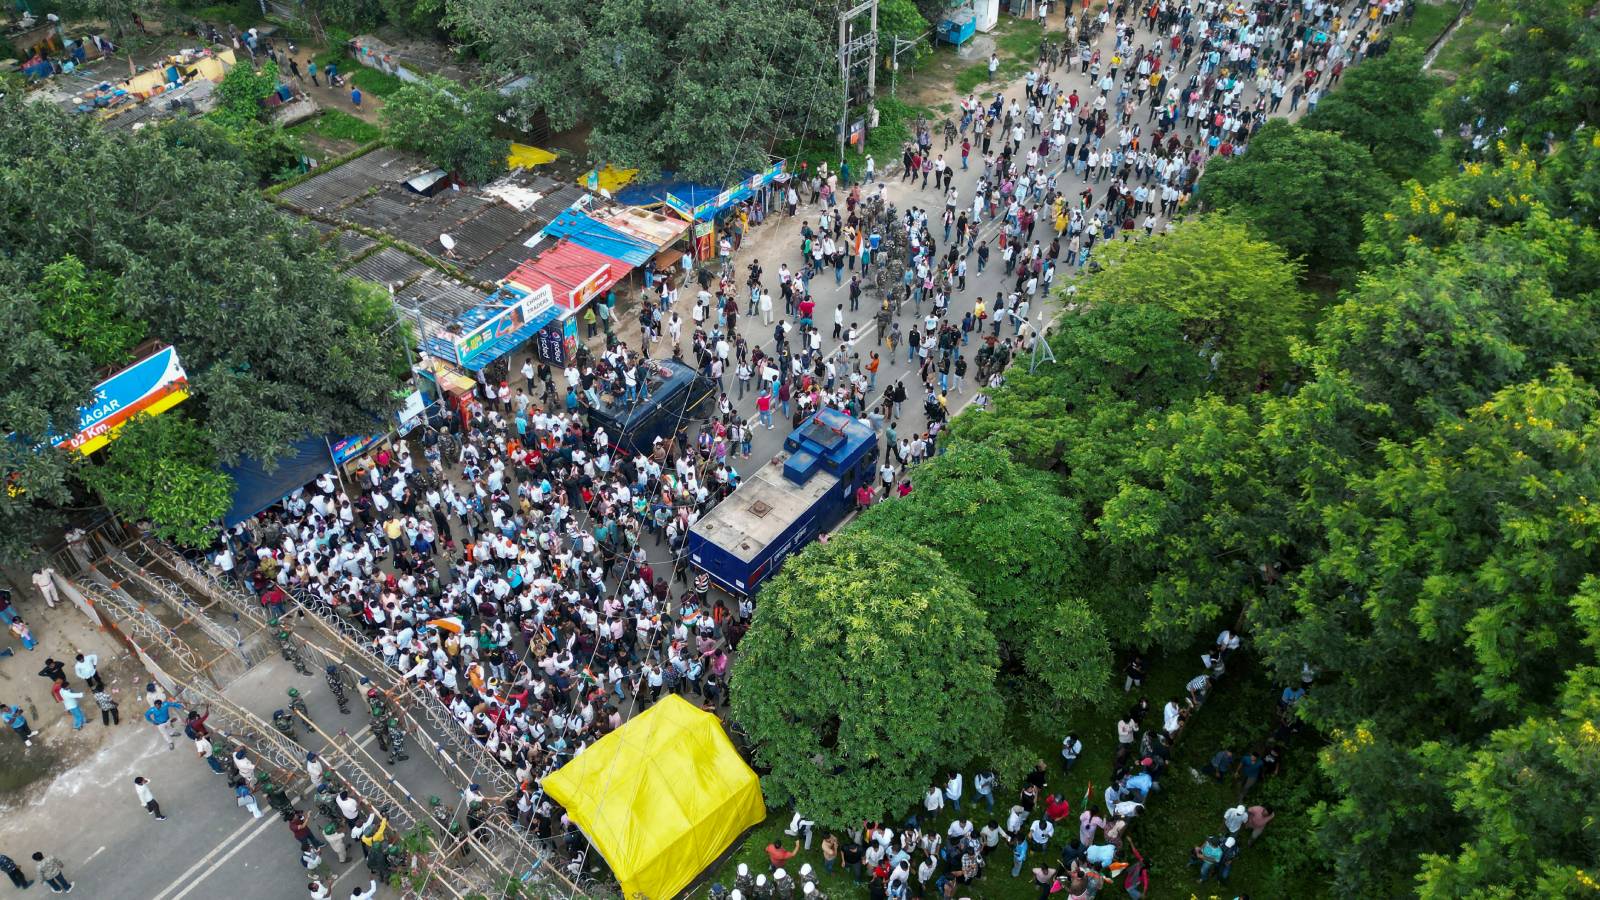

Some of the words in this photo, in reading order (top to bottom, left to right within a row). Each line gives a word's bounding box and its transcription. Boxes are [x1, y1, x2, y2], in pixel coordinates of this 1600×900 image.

[527, 298, 549, 313] TRADERS
[540, 337, 550, 359] pepsi
[551, 340, 562, 363] pepsi
